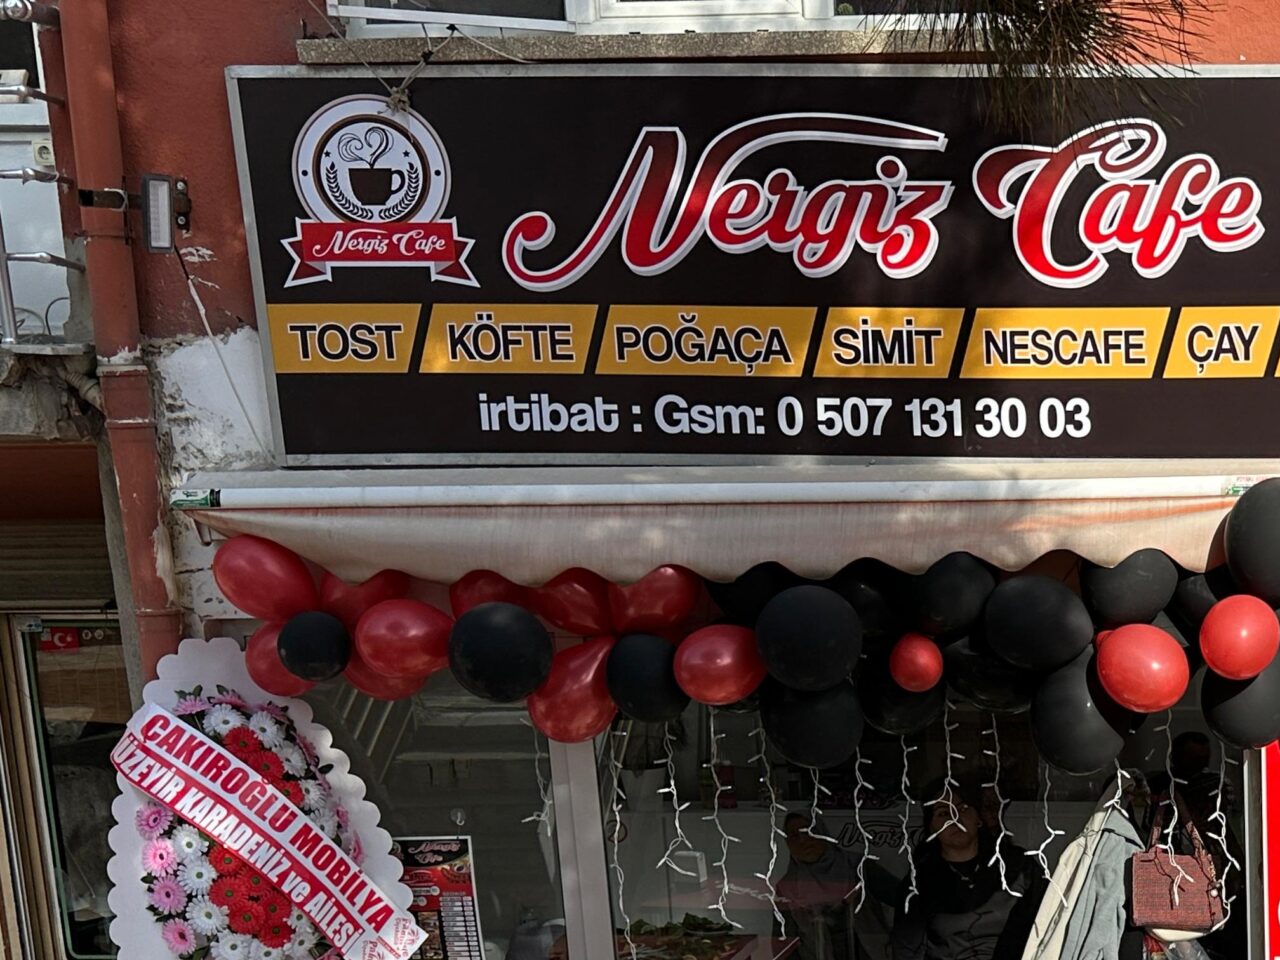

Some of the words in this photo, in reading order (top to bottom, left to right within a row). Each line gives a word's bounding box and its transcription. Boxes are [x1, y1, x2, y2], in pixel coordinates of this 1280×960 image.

[501, 112, 954, 292] Nergiz
[972, 118, 1265, 289] Cafe
[312, 229, 388, 256] Nergiz
[391, 229, 447, 256] Cafe
[288, 323, 404, 363] TOST
[446, 312, 575, 363] KÖFTE
[614, 314, 793, 375] POĞAÇA
[832, 317, 943, 366] SİMİT
[983, 328, 1146, 366] NESCAFE
[1186, 324, 1260, 375] ÇAY
[479, 393, 619, 434] irtibat
[653, 394, 766, 436] Gsm:
[776, 395, 804, 438] 0
[816, 396, 893, 438] 507
[904, 397, 963, 438] 131
[974, 397, 1027, 439] 30
[1039, 397, 1093, 439] 03
[111, 735, 186, 804] ÜZEYİR
[174, 787, 291, 883] KARADENİZ
[281, 872, 311, 902] ve
[303, 890, 364, 954] AİLESİ
[140, 714, 298, 833] ÇAKIROĞLU
[289, 823, 395, 934] MOBİLYA
